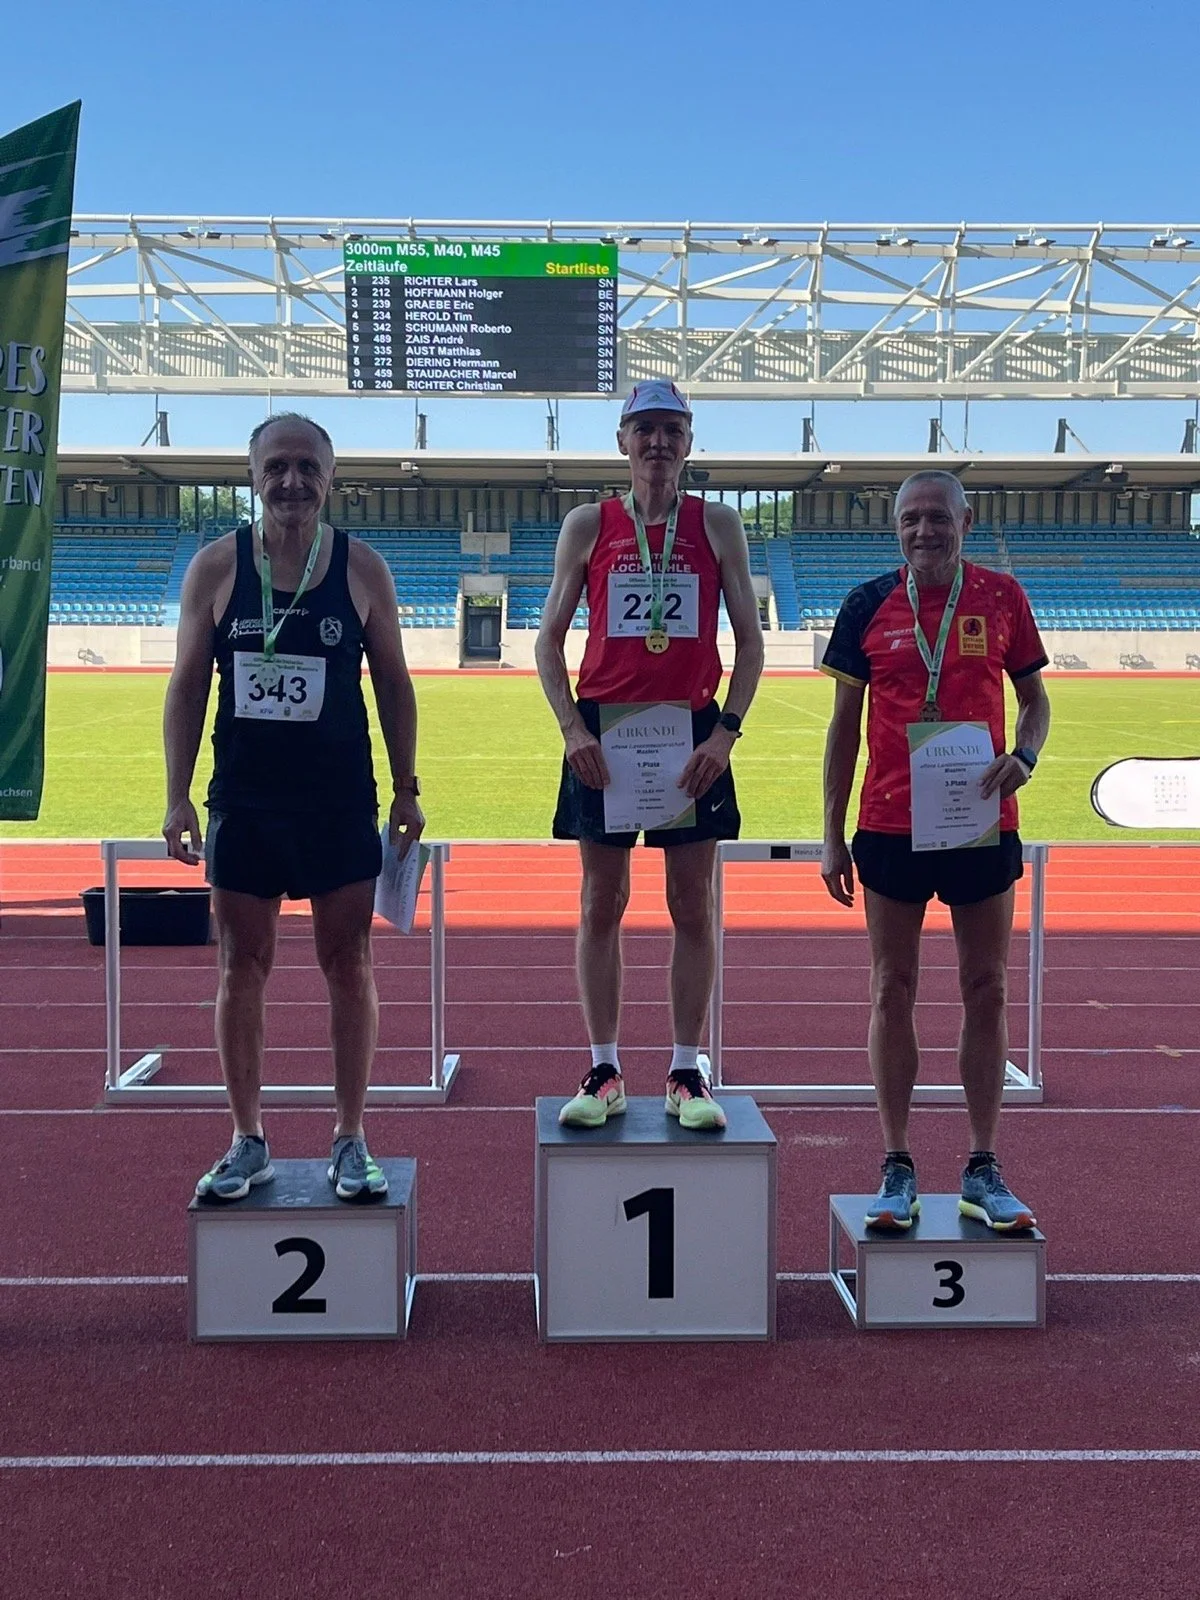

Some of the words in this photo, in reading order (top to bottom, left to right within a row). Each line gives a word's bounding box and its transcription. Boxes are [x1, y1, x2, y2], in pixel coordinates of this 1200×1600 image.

[345, 243, 392, 255] 3000m
[396, 244, 429, 257] M55,
[434, 244, 467, 258] M40,
[471, 245, 501, 257] M45
[345, 260, 408, 272] Zeitläufe
[546, 262, 610, 275] Startliste
[351, 276, 357, 285] 1
[372, 276, 390, 285] 235
[404, 277, 452, 286] RICHTER
[455, 277, 478, 286] Lars
[598, 279, 614, 288] SN
[351, 288, 358, 296] 2
[372, 288, 390, 297] 212
[405, 288, 466, 298] HOFFMANN
[469, 289, 504, 300] Holger
[598, 290, 613, 299] BE
[352, 299, 358, 308] 3
[372, 299, 391, 308] 239
[405, 300, 452, 309] GRAEBE
[454, 300, 474, 310] Eric
[598, 302, 614, 311] SN
[352, 311, 359, 319] 4
[372, 311, 391, 320] 234
[405, 311, 450, 321] HEROLD
[453, 312, 472, 321] Tim
[598, 313, 613, 323] SN
[352, 323, 359, 331] 5
[373, 323, 392, 332] 342
[405, 323, 468, 333] SCHUMANN
[470, 324, 512, 333] Roberto
[598, 325, 613, 334] SN
[352, 334, 359, 343] 6
[405, 335, 430, 344] ZAIS
[598, 337, 613, 346] SN
[353, 346, 359, 354] 7
[373, 346, 392, 355] 335
[406, 346, 435, 355] AUST
[437, 347, 481, 356] Matthias
[598, 348, 613, 357] SN
[0, 340, 46, 395] ES
[353, 357, 360, 366] 8
[374, 357, 392, 366] 272
[406, 358, 451, 367] DIERING
[453, 358, 500, 368] Hermann
[598, 360, 613, 369] SN
[354, 369, 360, 377] 9
[374, 369, 392, 378] 459
[406, 369, 480, 378] STAUDACHER
[482, 370, 517, 379] Marcel
[598, 371, 613, 380] SN
[352, 380, 364, 389] 10
[375, 380, 393, 389] 240
[406, 381, 454, 390] RICHTER
[456, 381, 503, 390] Christian
[598, 382, 613, 391] SN
[248, 673, 307, 704] 343
[622, 1187, 675, 1300] 1
[271, 1236, 327, 1314] 2
[931, 1260, 966, 1309] 3
